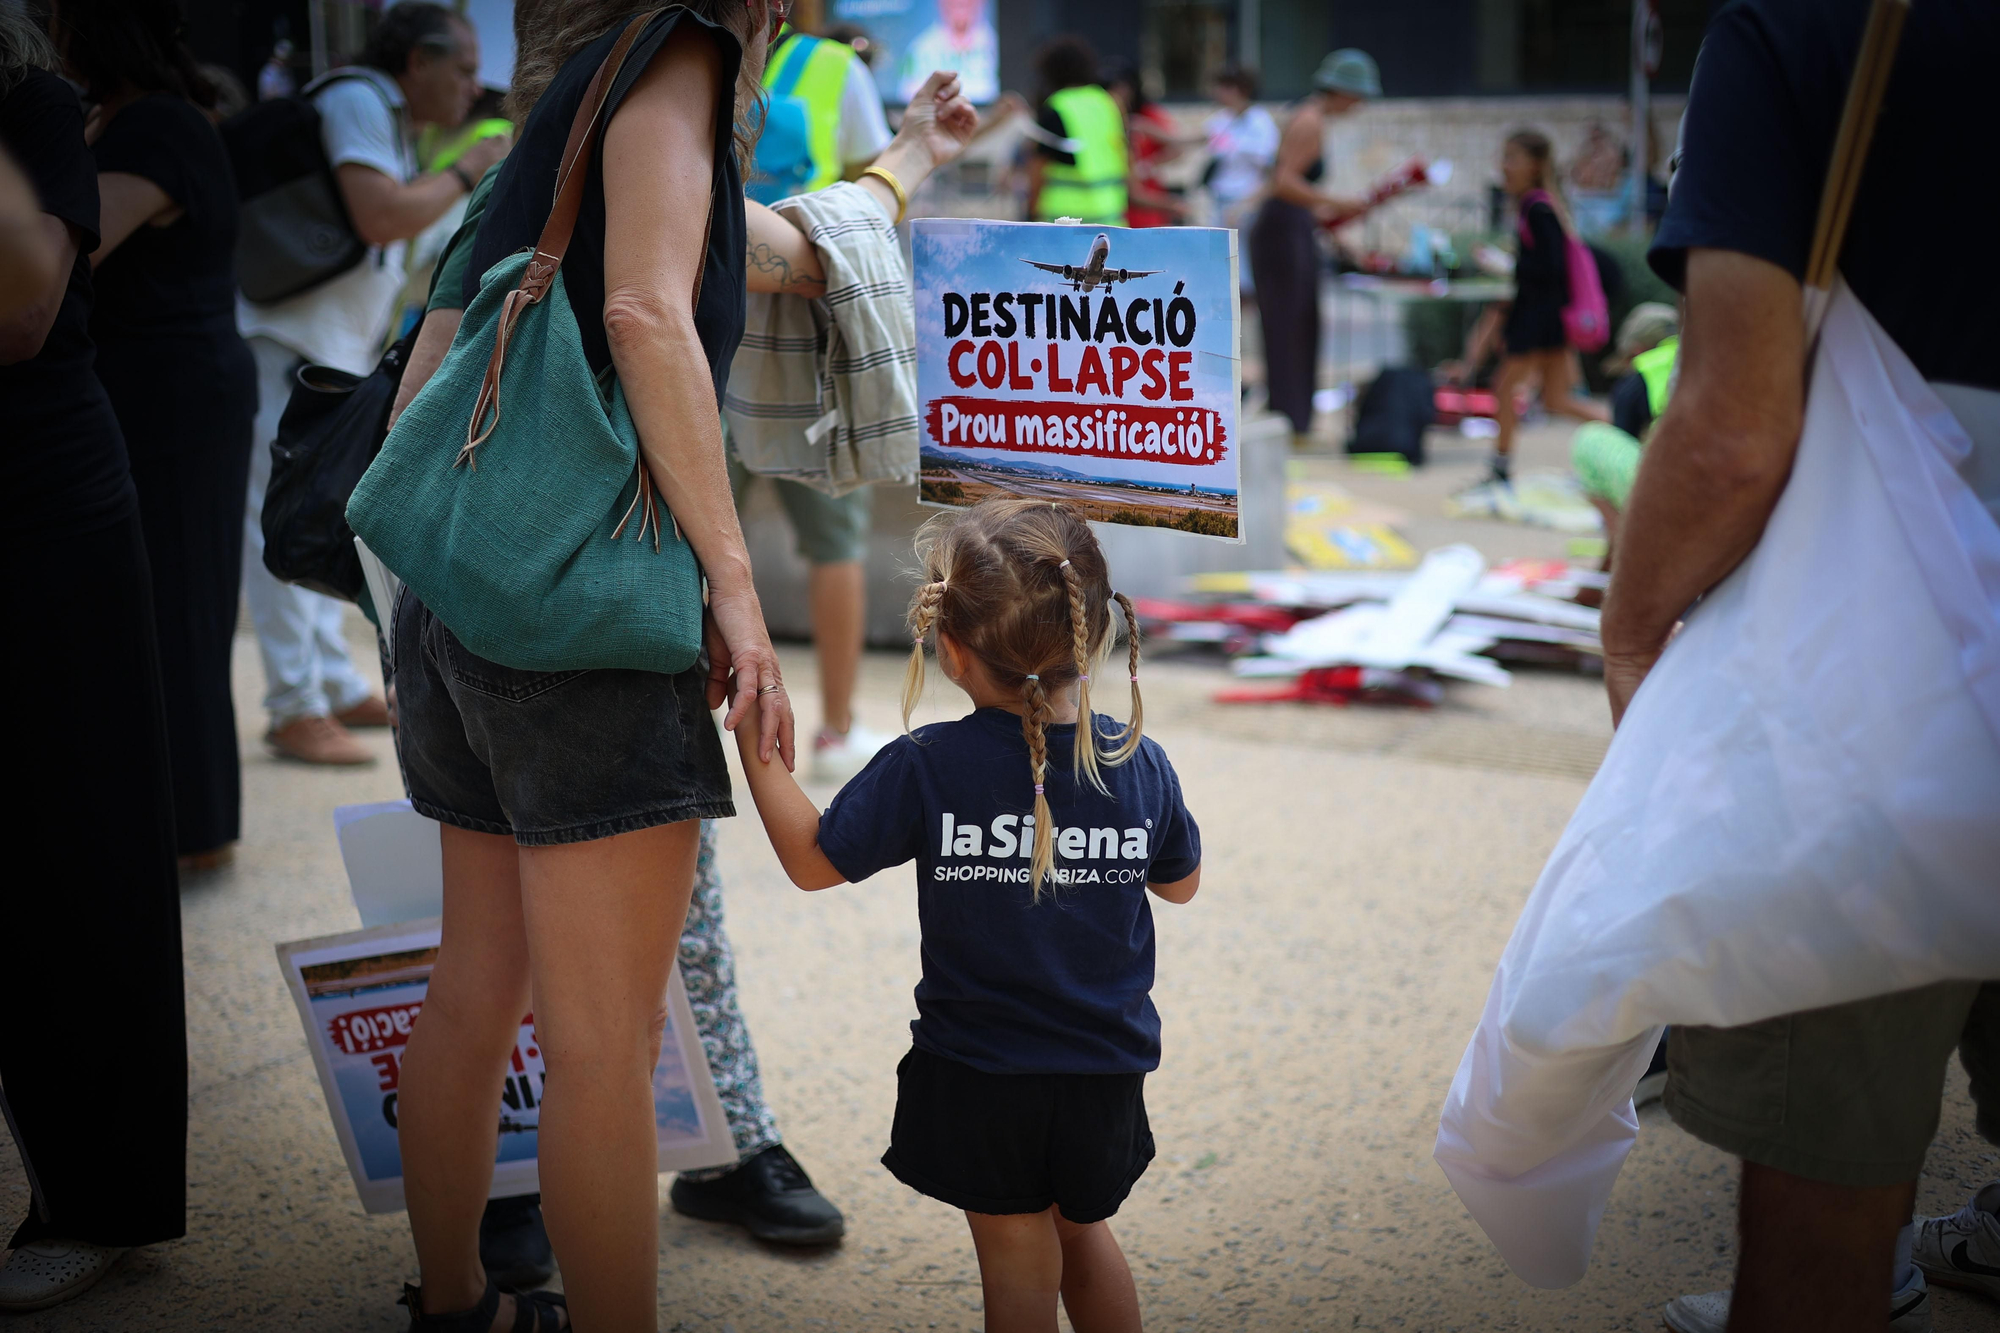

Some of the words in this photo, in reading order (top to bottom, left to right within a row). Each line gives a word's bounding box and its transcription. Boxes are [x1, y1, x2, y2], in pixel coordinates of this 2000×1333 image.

[942, 280, 1196, 347] DESTINACIÓ
[947, 340, 1194, 401] COL·LAPSE
[940, 403, 1007, 444] Prou
[1015, 409, 1215, 460] massificació!
